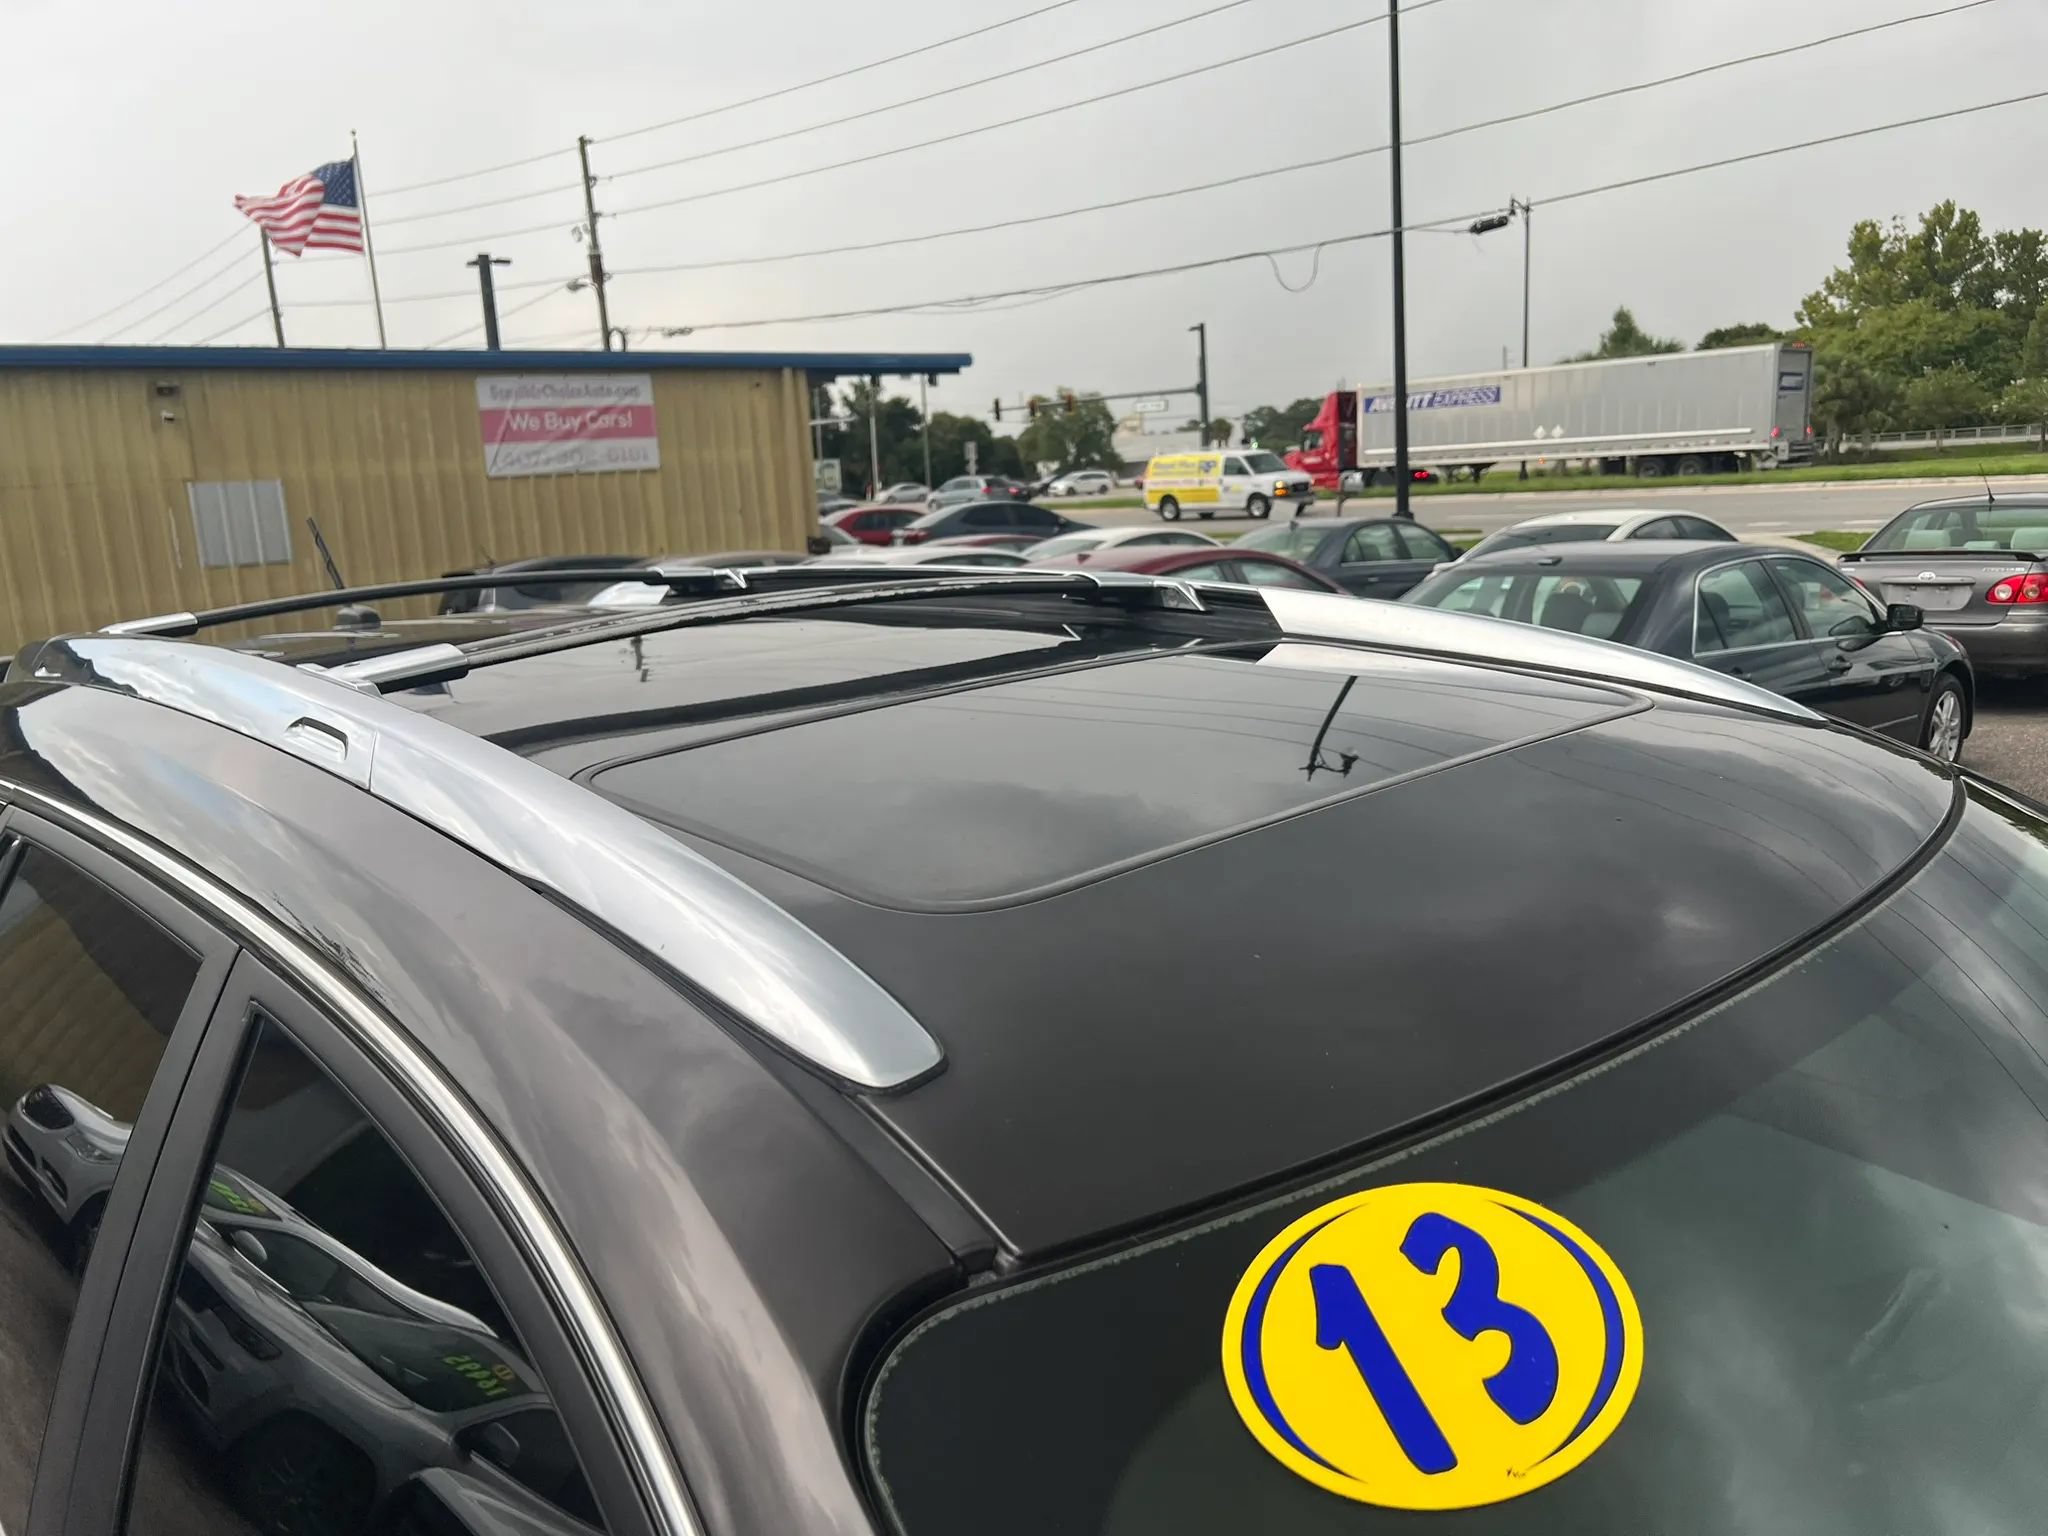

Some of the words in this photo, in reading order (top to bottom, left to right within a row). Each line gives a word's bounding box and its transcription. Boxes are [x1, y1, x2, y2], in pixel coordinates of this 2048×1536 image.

[509, 414, 541, 433] We
[544, 411, 583, 433] Buy
[586, 409, 633, 431] Cars!
[1309, 1211, 1560, 1475] 13
